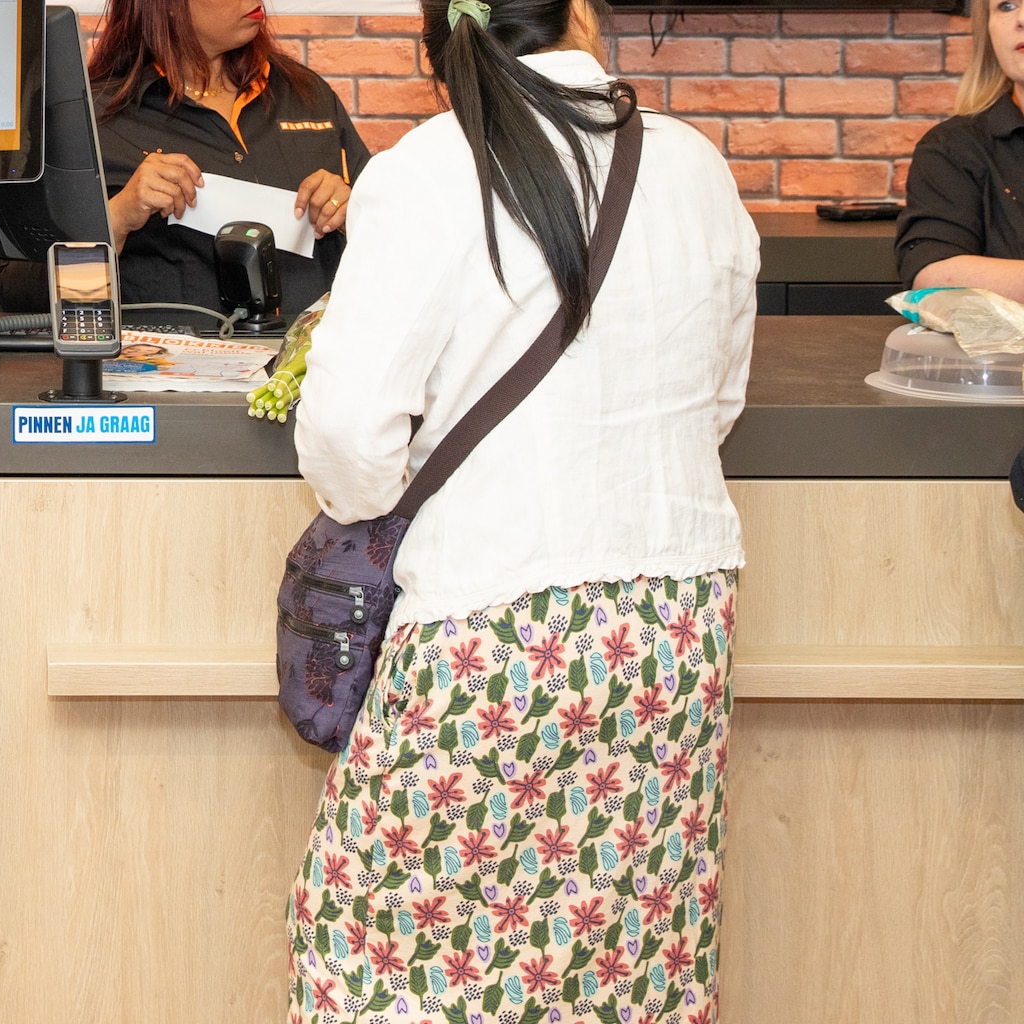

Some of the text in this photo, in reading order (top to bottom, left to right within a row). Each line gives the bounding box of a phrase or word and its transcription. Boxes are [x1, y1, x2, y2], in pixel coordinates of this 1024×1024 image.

[18, 416, 150, 433] PINNEN JA GRAAG
